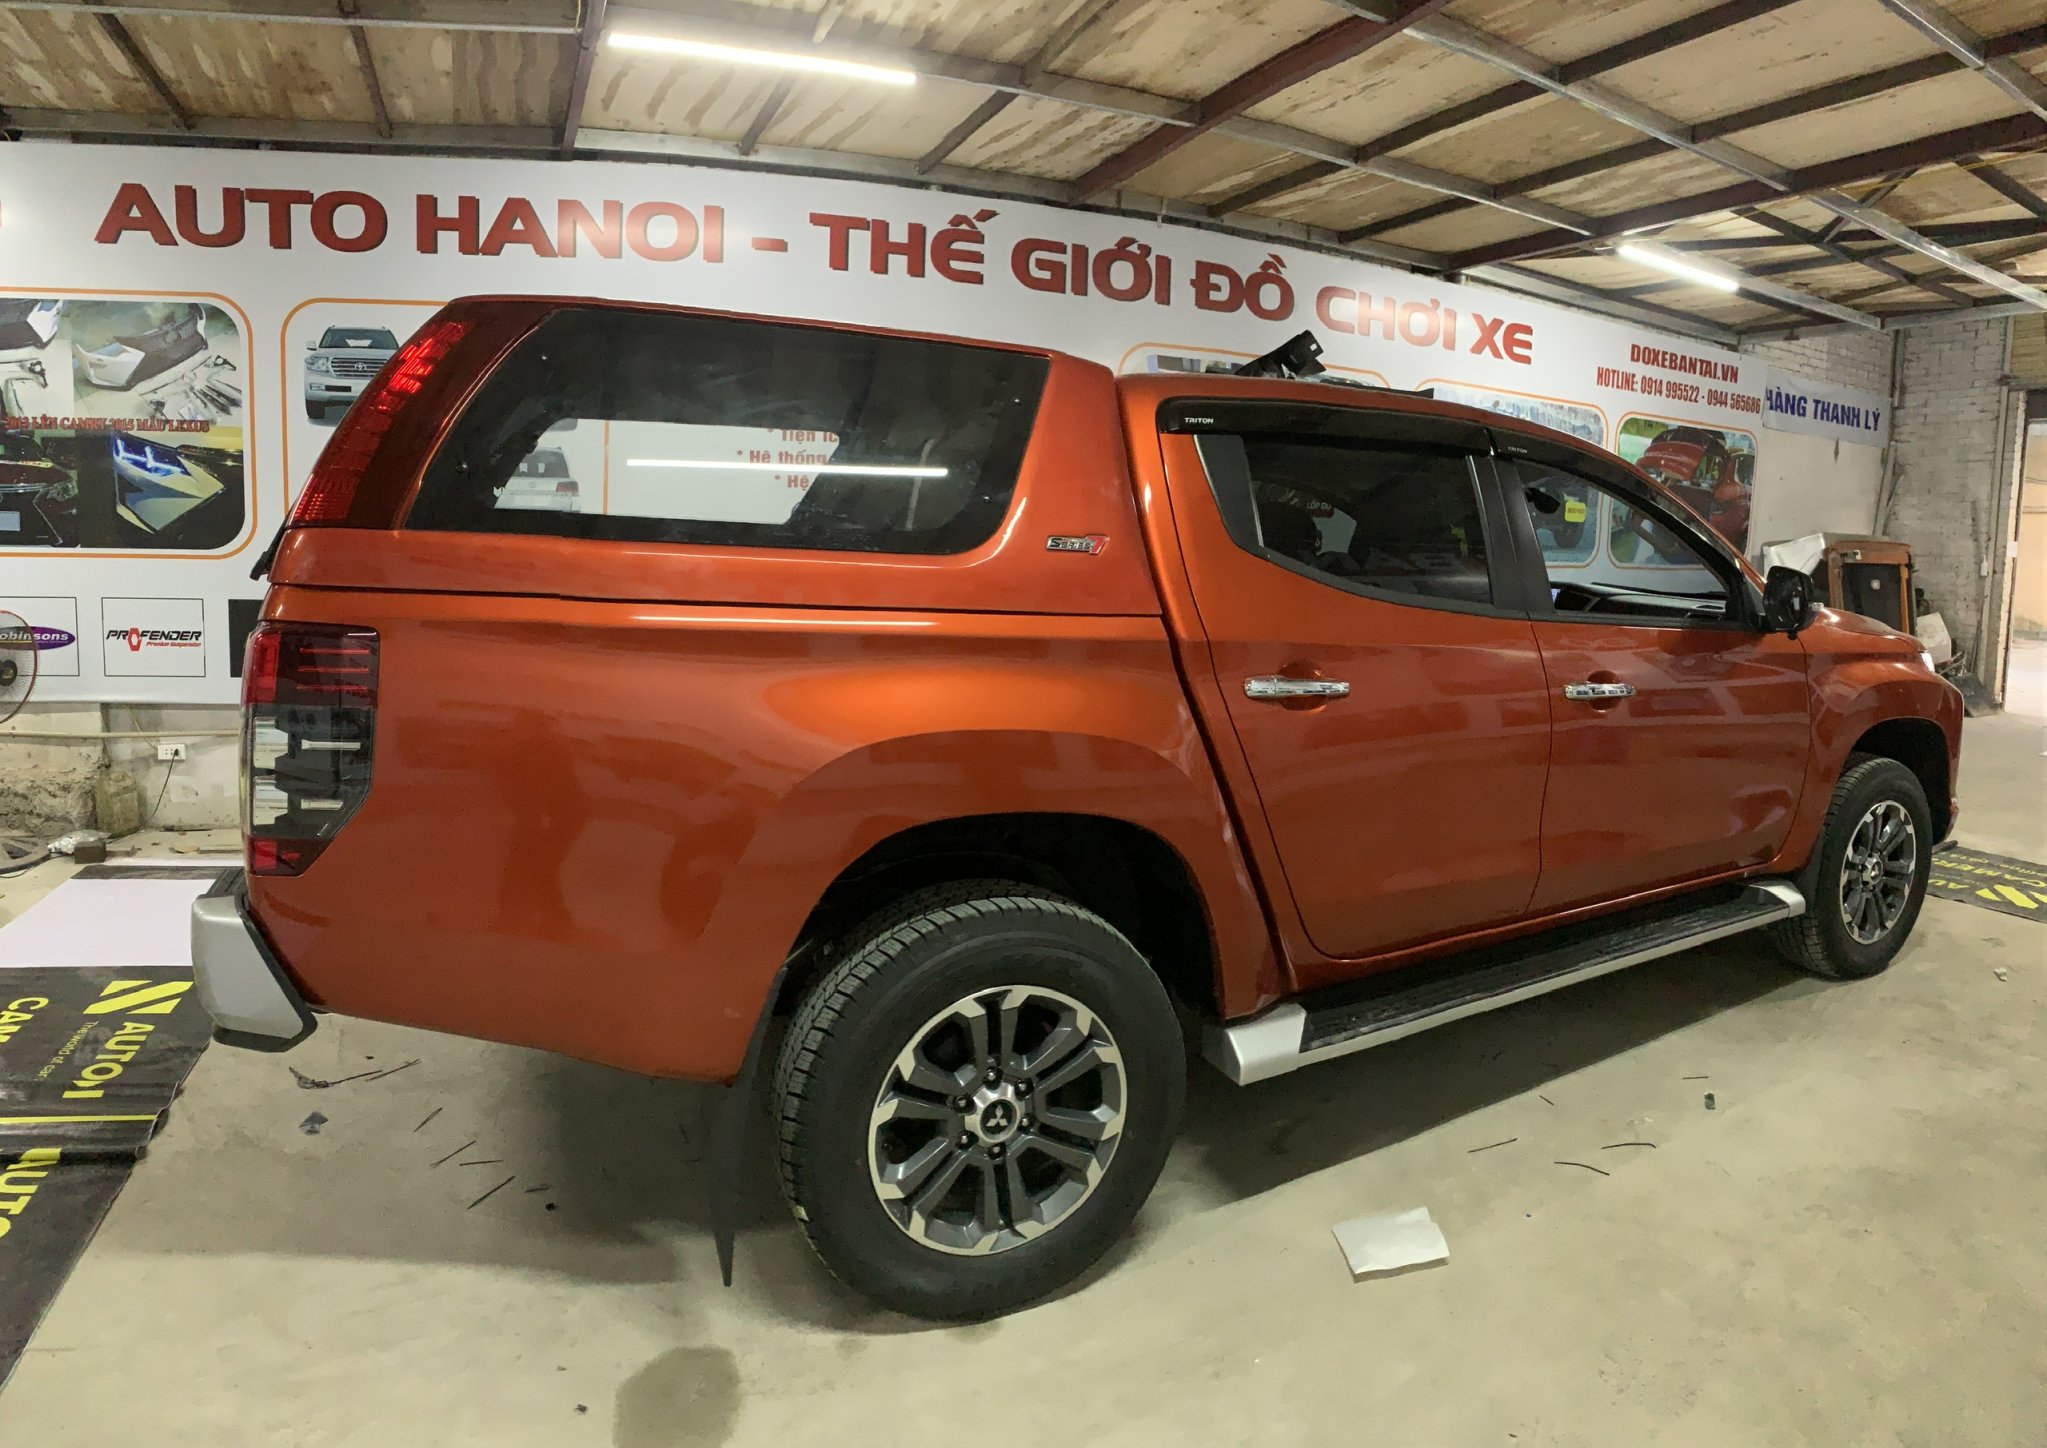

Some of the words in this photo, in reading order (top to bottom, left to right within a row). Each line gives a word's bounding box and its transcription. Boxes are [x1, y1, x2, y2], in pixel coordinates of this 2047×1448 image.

[95, 183, 388, 252] AUTO
[416, 194, 724, 263] HANOI
[809, 208, 1000, 285] THẾ
[1011, 235, 1171, 306] GIỚI
[1190, 253, 1295, 321] ĐỒ
[1315, 285, 1456, 351] CHƠI
[1470, 313, 1533, 364] XE
[1630, 343, 1739, 384] DOXEBANTAI.VN
[1597, 366, 1638, 392] HOTLINE:
[1640, 376, 1663, 397] 0914
[1665, 380, 1699, 403] 995522
[1707, 389, 1728, 408] 0944
[1730, 393, 1761, 414] 565686
[1765, 386, 1807, 418] HÀNG
[1813, 399, 1860, 428] THANH
[1864, 408, 1880, 431] LÝ
[60, 416, 107, 431] CAMRY
[168, 418, 209, 433] LEXUS
[106, 628, 202, 651] PROFENDER
[58, 1033, 81, 1054] world
